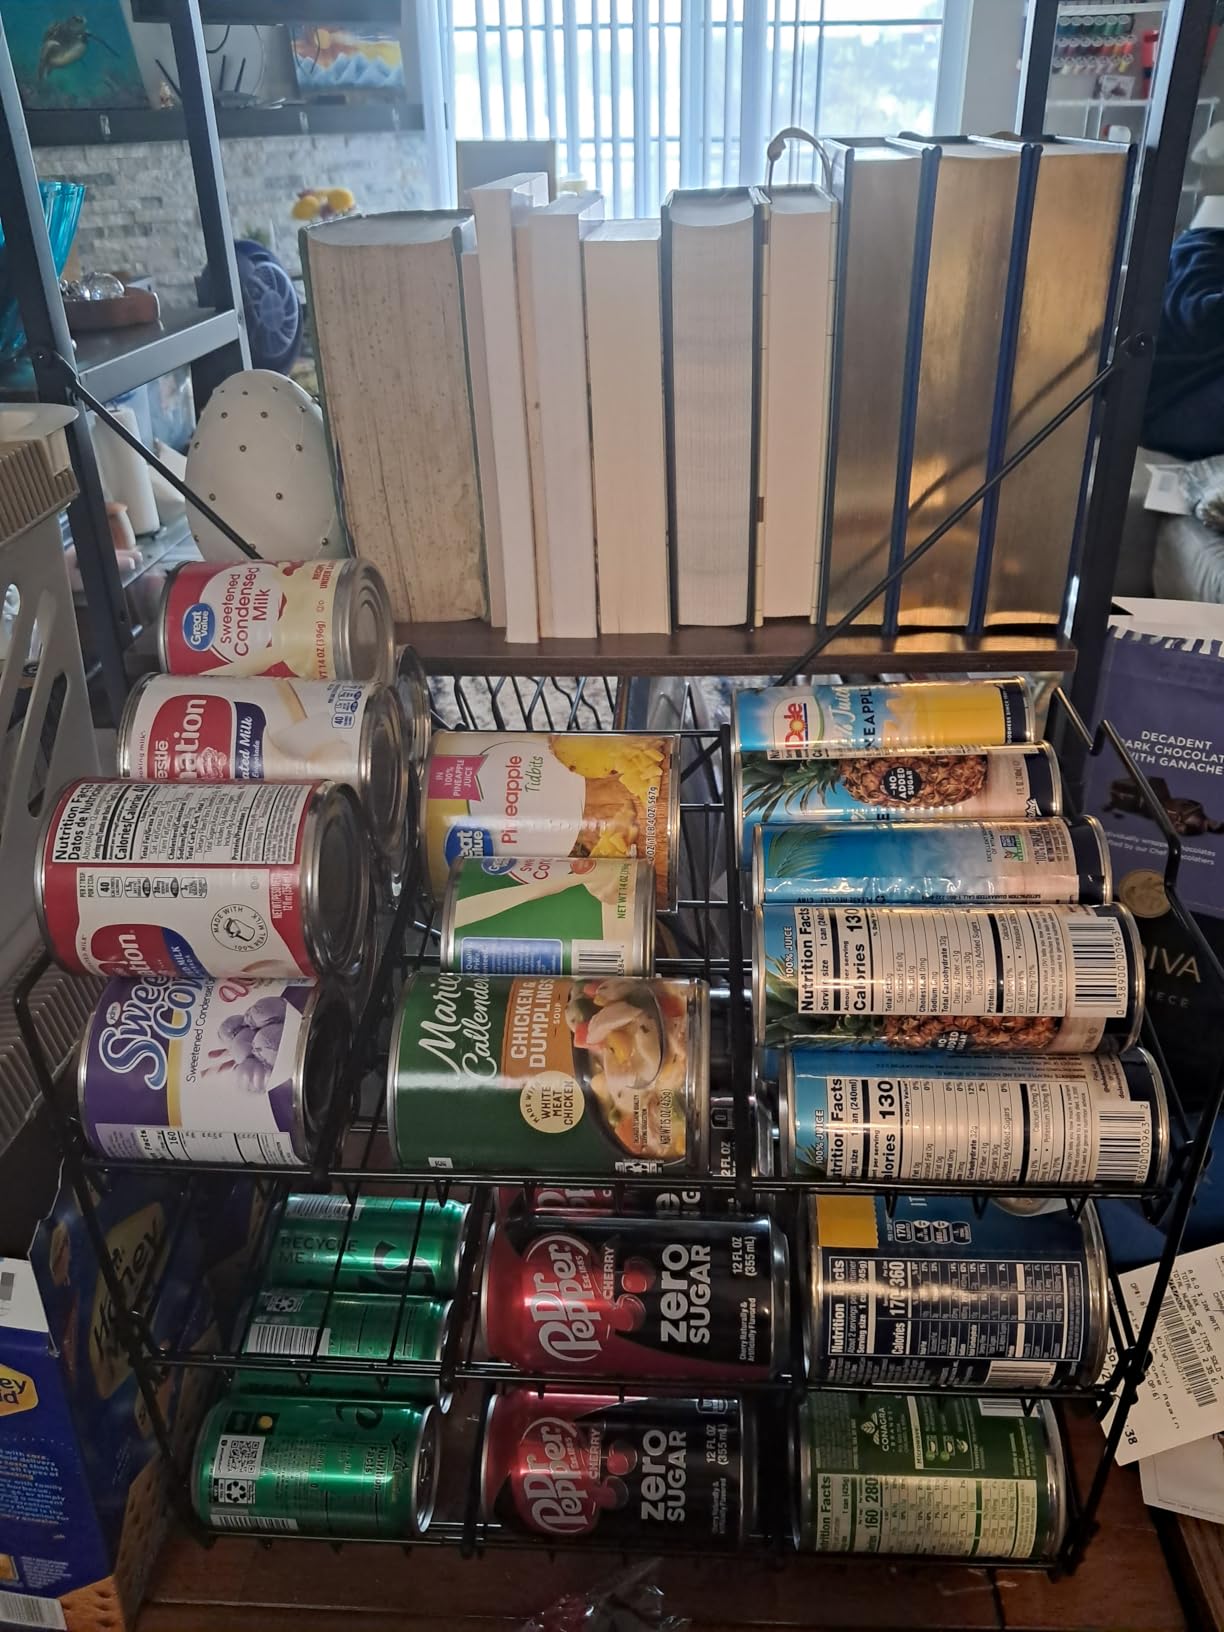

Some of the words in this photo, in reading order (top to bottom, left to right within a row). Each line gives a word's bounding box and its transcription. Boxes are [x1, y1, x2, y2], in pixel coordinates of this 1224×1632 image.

[220, 574, 240, 644] Sweetened
[234, 567, 259, 656] Condensed
[252, 589, 270, 621] Milk
[190, 611, 203, 645] Great
[200, 611, 209, 636] Value
[240, 716, 253, 747] Milk
[783, 702, 804, 747] Dole
[1140, 730, 1213, 750] DECADENT
[155, 740, 169, 778] estlé
[1154, 744, 1224, 764] CHOCOLAT
[1159, 757, 1224, 776] GANACHE
[445, 766, 455, 786] 100%
[454, 760, 466, 797] PINEAPPLE
[464, 767, 474, 788] JUICE
[524, 755, 544, 793] Tidbits
[888, 775, 898, 790] NO
[896, 767, 909, 799] ADDED
[905, 770, 916, 795] SUGAR
[500, 755, 521, 845] Pieapple
[648, 787, 660, 804] 567g
[55, 806, 79, 860] Nutrition
[70, 784, 94, 803] Facts
[75, 816, 88, 828] de
[68, 830, 84, 860] Datos
[100, 882, 110, 893] 40
[617, 891, 627, 903] WT
[213, 914, 223, 933] MADE
[223, 906, 243, 915] WITH
[250, 913, 265, 930] MILK
[616, 904, 627, 919] NET
[797, 907, 812, 935] Facts
[844, 908, 863, 932] 130
[783, 926, 794, 951] JUICE
[970, 921, 982, 938] Sugars
[963, 951, 974, 964] 30g
[973, 939, 983, 958] Added
[1112, 930, 1124, 959] 00963
[784, 953, 795, 978] 100%
[800, 940, 815, 1011] Nutrition
[820, 960, 829, 977] size
[939, 948, 951, 995] Carbohydrate
[952, 963, 961, 980] Fiber
[964, 965, 976, 986] Sugars
[975, 969, 984, 996] Includes
[1117, 965, 1127, 998] 38900
[884, 996, 893, 1012] Total
[929, 988, 938, 1013] Sodium
[940, 996, 949, 1013] Total
[964, 987, 972, 1004] Total
[986, 989, 996, 1013] Protein
[418, 974, 463, 1080] Marie
[509, 988, 535, 1059] CHICKEN
[529, 979, 557, 1068] DUMPLINGS
[552, 1002, 562, 1025] SOUP
[98, 977, 168, 1091] Swee
[185, 1028, 203, 1083] Sweetened
[196, 987, 214, 1027] Condensed
[461, 974, 499, 1081] Callender
[539, 1087, 552, 1120] WHITE
[552, 1090, 564, 1117] MEAT
[563, 1079, 575, 1126] CHICKEN
[659, 1088, 673, 1109] (425g)
[830, 1078, 844, 1121] Facts
[849, 1079, 860, 1110] (240ml)
[877, 1080, 896, 1119] 130
[1031, 1092, 1041, 1108] 30mg
[525, 1103, 540, 1124] MADE
[903, 1100, 911, 1117] Daily
[1002, 1107, 1013, 1130] Sugars
[1032, 1109, 1041, 1133] Calcium
[167, 1131, 179, 1145] 160
[815, 1109, 825, 1140] JUICE
[1042, 1113, 1052, 1144] Potassium
[1140, 1122, 1150, 1154] 00963
[815, 1142, 825, 1164] 100%
[873, 1129, 882, 1156] serving
[1002, 1130, 1012, 1151] Added
[851, 1149, 859, 1164] size
[881, 1133, 896, 1179] alories
[966, 1139, 978, 1178] Carbohydrate
[731, 1236, 743, 1249] OZ
[896, 1223, 906, 1238] 170
[732, 1249, 744, 1261] FL
[744, 1236, 757, 1253] mL)
[602, 1246, 616, 1300] CHERRY
[732, 1262, 744, 1275] 12
[743, 1254, 758, 1277] (355
[889, 1261, 906, 1287] 360
[659, 1243, 690, 1343] zero
[689, 1244, 712, 1344] SUGAR
[1181, 1270, 1193, 1291] TOTAL
[530, 1272, 569, 1323] Dr
[546, 1243, 603, 1351] Pepper
[747, 1298, 757, 1329] Flavored
[848, 1306, 859, 1333] servings
[857, 1314, 867, 1329] size
[1171, 1269, 1184, 1289] TOTAL
[1182, 1292, 1197, 1317] NUMBER
[1199, 1331, 1213, 1353] ITEMS
[1210, 1355, 1222, 1373] SOLD
[831, 1303, 845, 1353] Nutrition
[857, 1329, 868, 1354] Serving
[891, 1322, 906, 1355] Calories
[1162, 1392, 1180, 1430] Again
[706, 1424, 718, 1436] OZ
[706, 1436, 718, 1450] FL
[878, 1407, 893, 1452] CONAGRA
[588, 1428, 601, 1480] CHERRY
[705, 1450, 718, 1463] 12
[716, 1441, 730, 1466] (355
[523, 1455, 561, 1499] Dr
[539, 1426, 589, 1526] Pepper
[640, 1429, 668, 1521] zero
[666, 1430, 688, 1522] SUGAR
[820, 1476, 831, 1513] Facts
[864, 1479, 879, 1503] 280
[864, 1509, 879, 1529] 160
